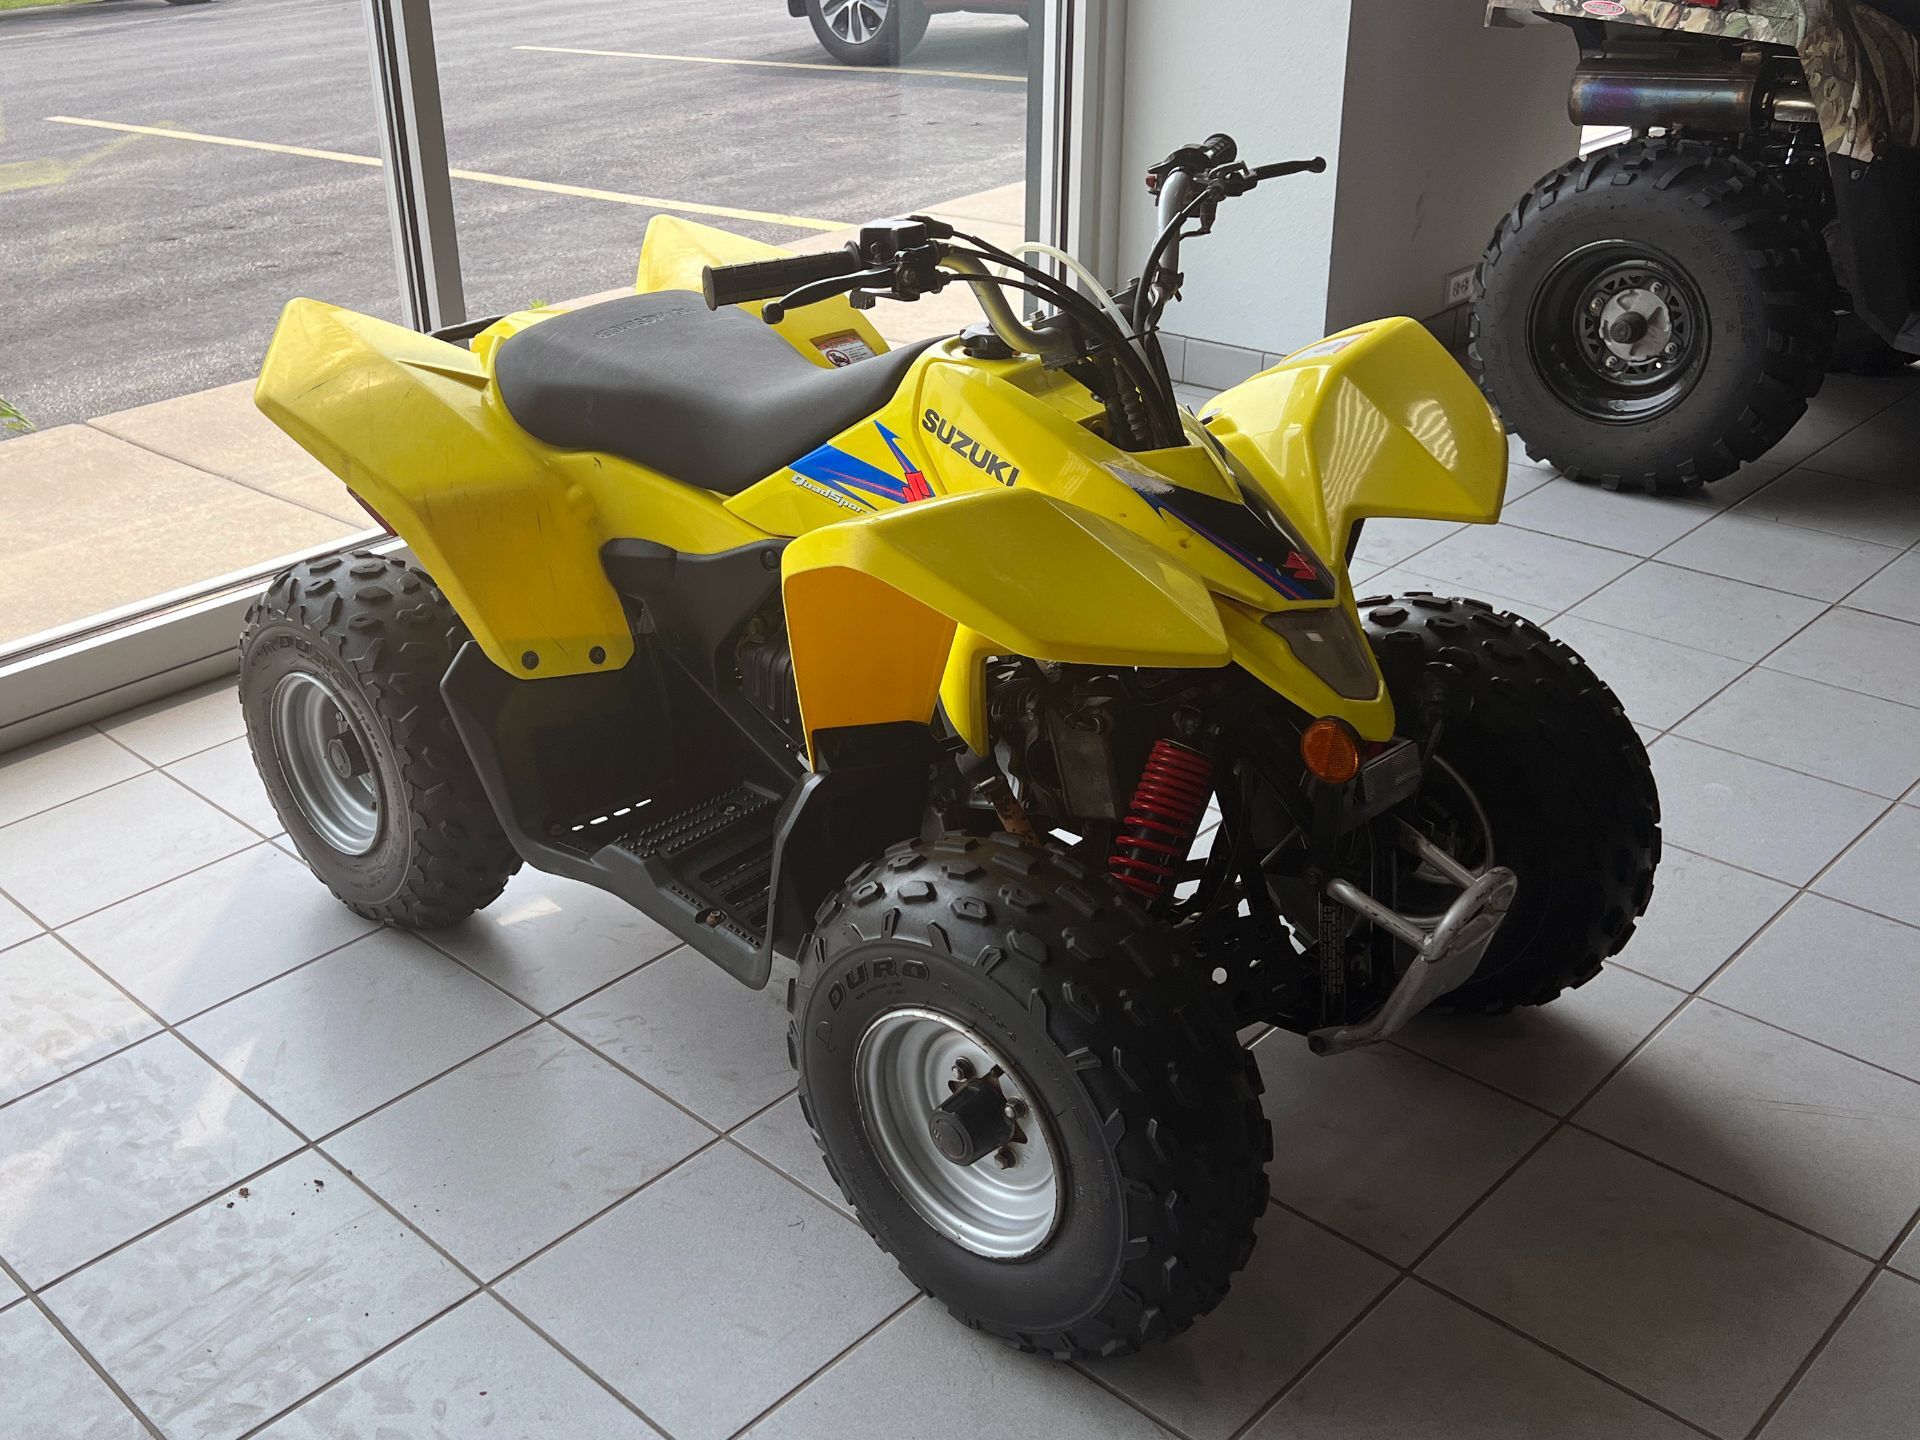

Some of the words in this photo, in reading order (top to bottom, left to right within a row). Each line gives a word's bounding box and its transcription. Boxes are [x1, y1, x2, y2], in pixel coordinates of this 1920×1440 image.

[922, 408, 1020, 487] SUZUKI
[791, 473, 870, 515] QuadSpor
[827, 957, 930, 1014] DURO
